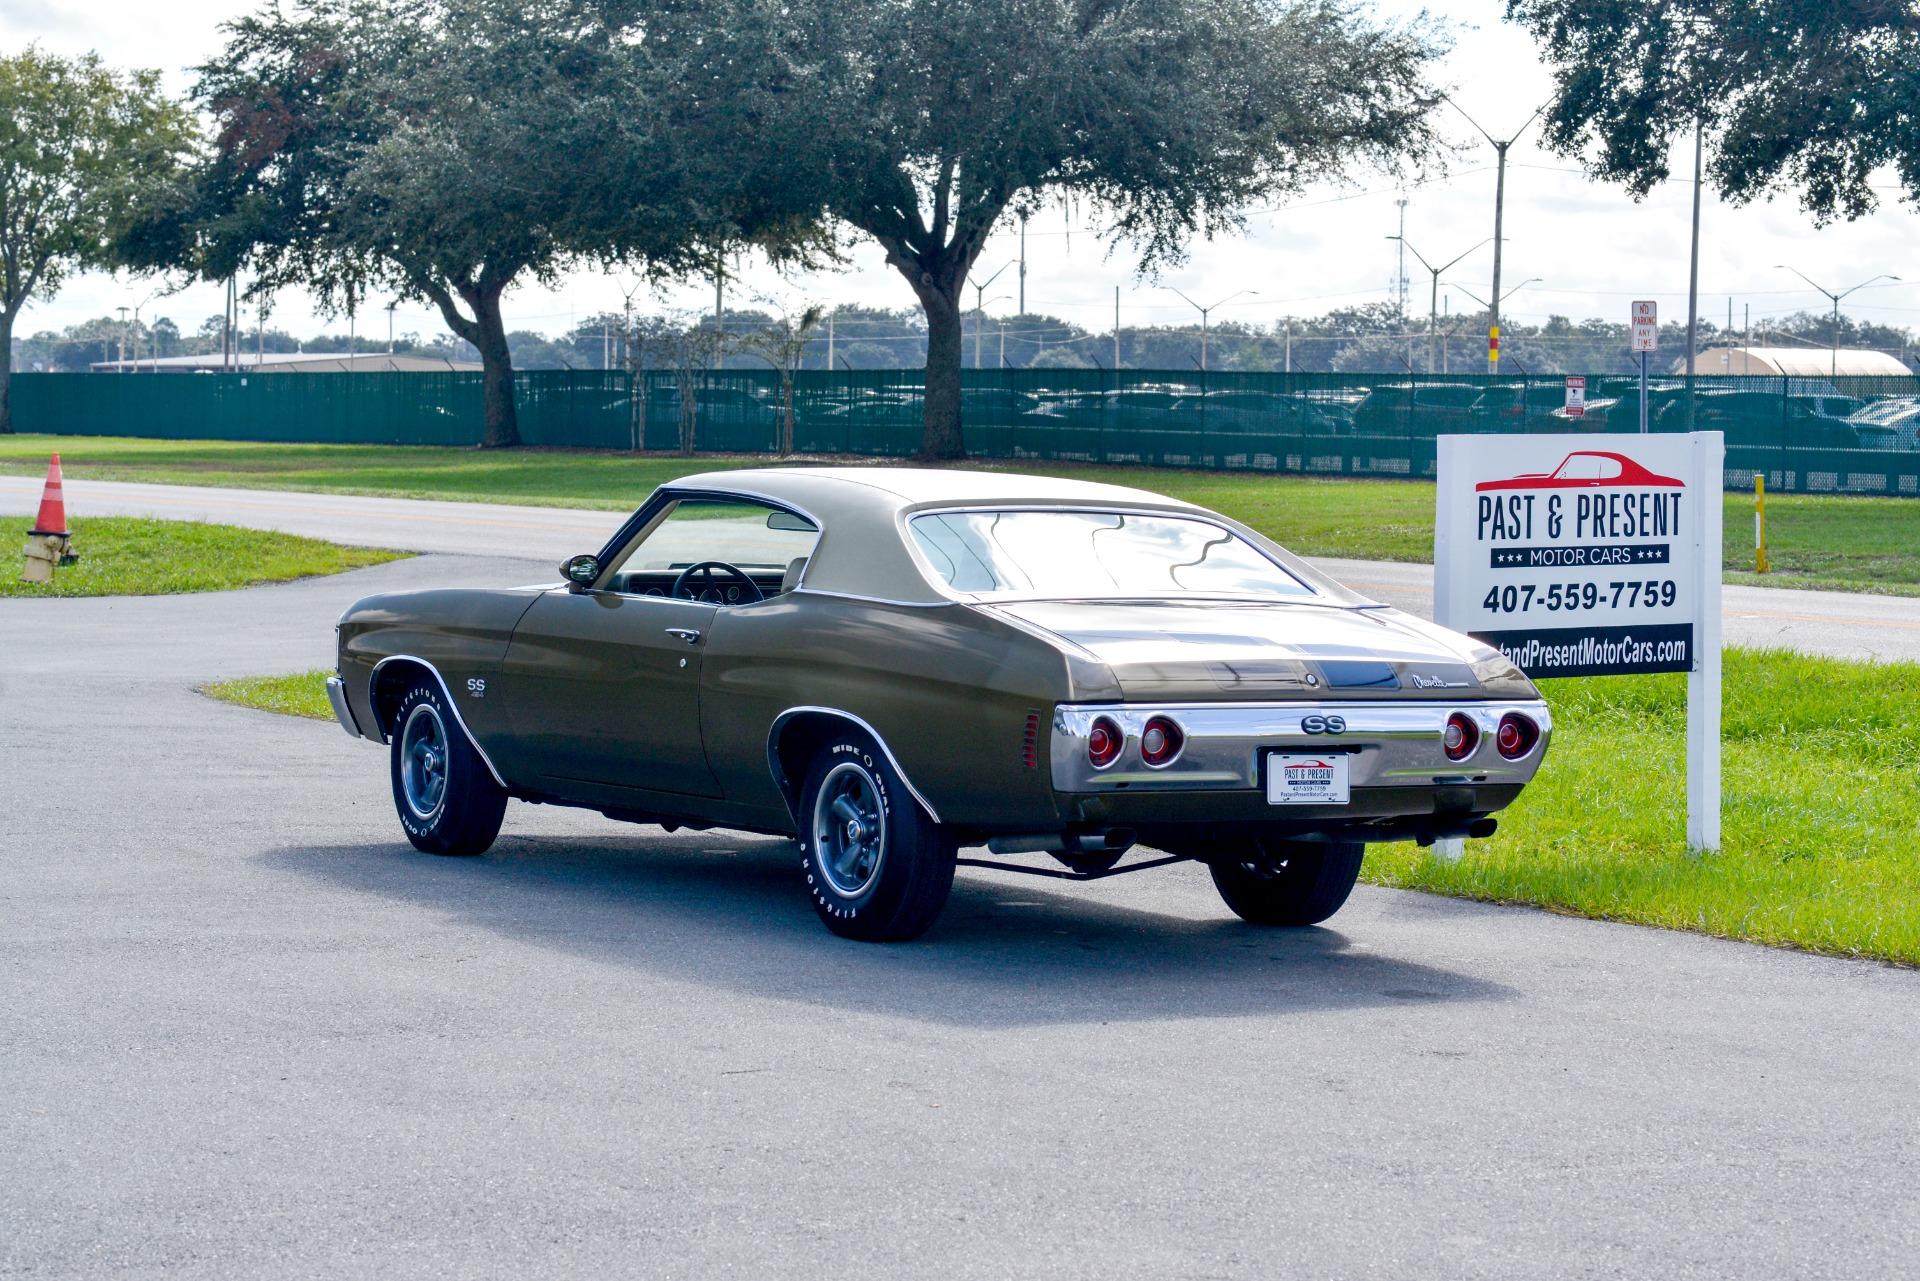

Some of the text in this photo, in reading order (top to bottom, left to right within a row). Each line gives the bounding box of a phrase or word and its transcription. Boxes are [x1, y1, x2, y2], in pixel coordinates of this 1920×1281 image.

[1639, 305, 1649, 314] NO
[1633, 316, 1655, 325] PARKING
[1637, 338, 1652, 347] TIME
[1478, 492, 1682, 540] PAST & PRESENT
[1530, 547, 1631, 566] MOTOR CARS
[1483, 580, 1677, 613] 407-559-7759
[467, 678, 485, 691] SS
[1303, 715, 1346, 734] SS
[1285, 769, 1334, 779] PAST & PRESENT
